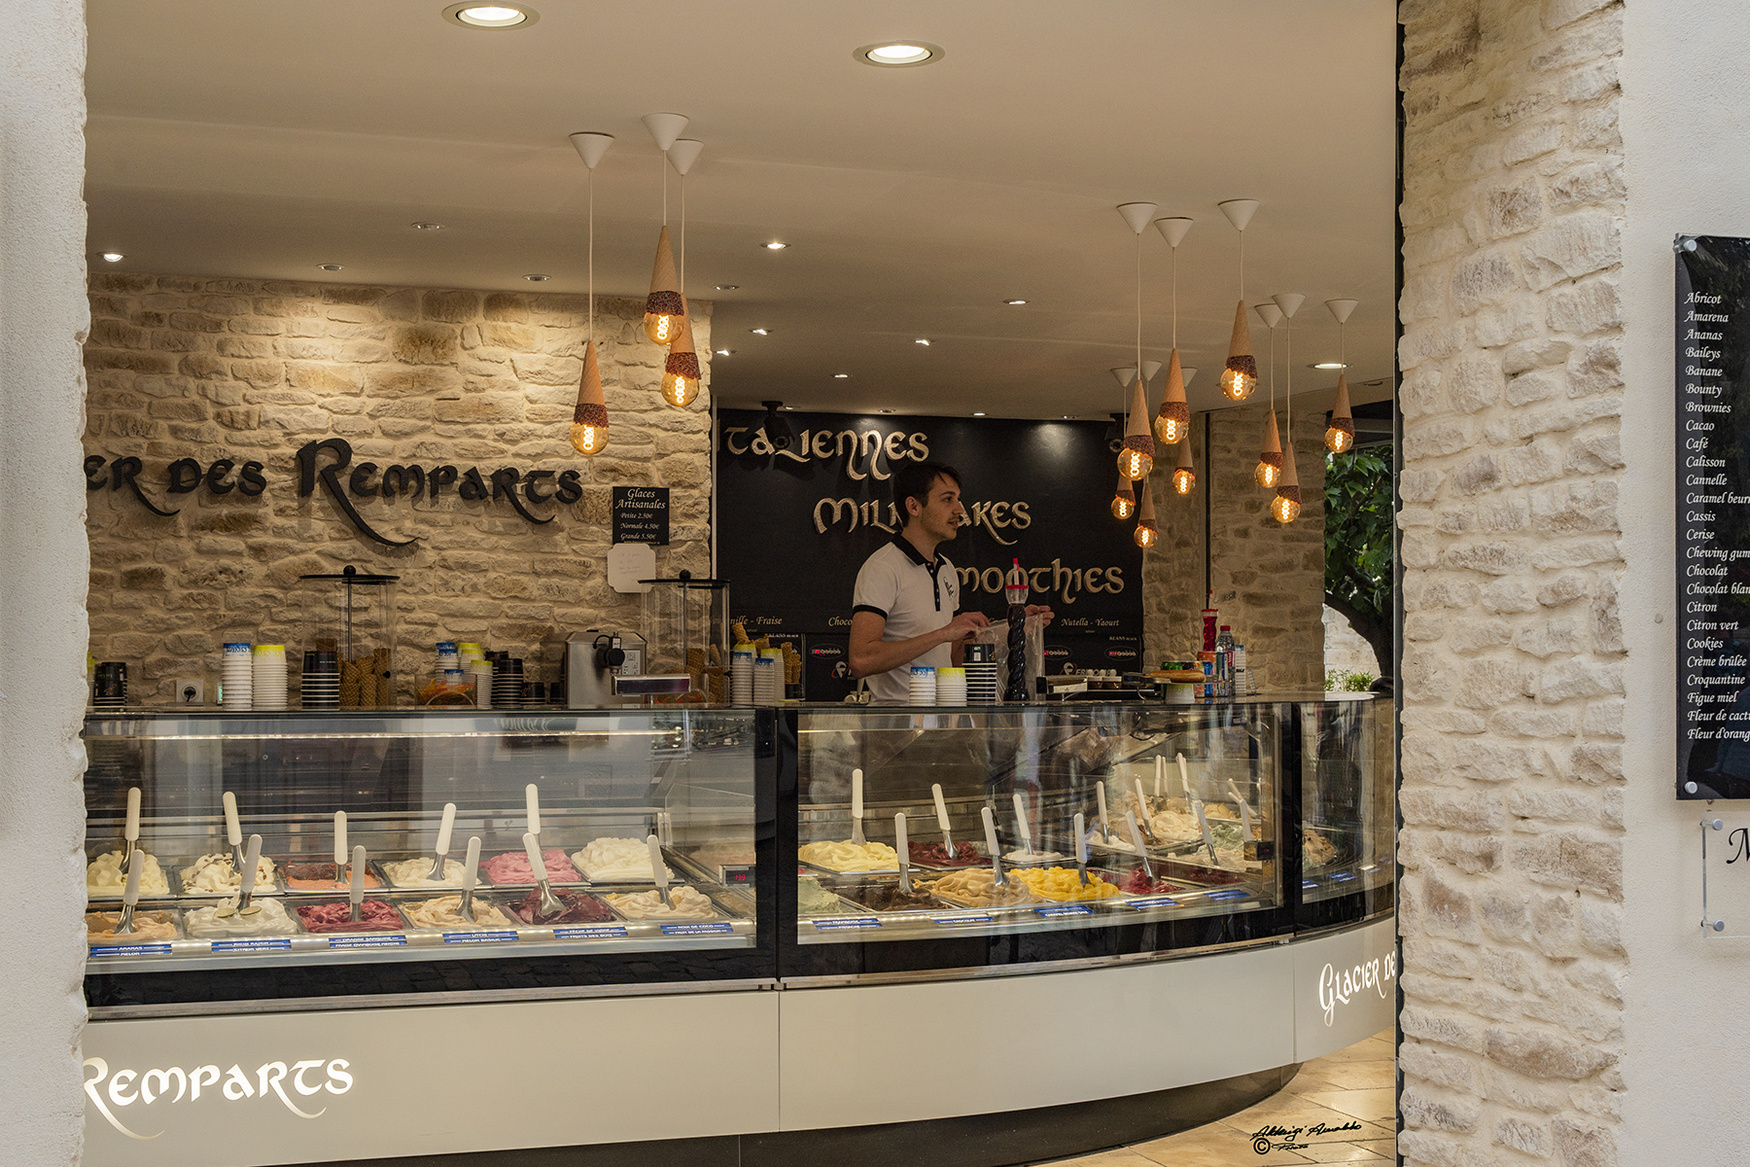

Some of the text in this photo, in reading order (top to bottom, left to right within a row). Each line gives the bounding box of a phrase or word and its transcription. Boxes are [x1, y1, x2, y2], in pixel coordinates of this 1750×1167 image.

[1683, 291, 1722, 305] Abricot
[1683, 310, 1729, 323] Amarena
[1683, 328, 1723, 341] Ananas
[1684, 346, 1722, 362] Baileys
[1684, 364, 1723, 377] Banane
[1684, 383, 1723, 399] Bounty
[1684, 401, 1732, 413] Brownies
[1685, 419, 1715, 432] Cacao
[1685, 437, 1709, 451] Café
[1685, 455, 1726, 468] Calisson
[1685, 474, 1728, 487] Cannelle
[627, 487, 656, 500] Glaces
[1686, 491, 1728, 504] Caramel
[615, 498, 666, 509] Artisanales
[1686, 510, 1717, 523] Cassis
[1686, 528, 1715, 541] Cerise
[1686, 546, 1750, 562] Chewing gum
[1686, 563, 1729, 577] Chocolat
[1686, 582, 1750, 596] Chocolat blan
[1686, 600, 1718, 614] Citron
[756, 615, 783, 626] Fraise
[1060, 617, 1089, 627] Nutella
[1095, 618, 1120, 627] Yaourt
[1686, 619, 1740, 632] Citron vert
[1686, 636, 1724, 651] Cookies
[1686, 654, 1747, 668] Crème brûlée
[1686, 673, 1746, 688] Croquantine
[1687, 690, 1739, 707] Figue miel
[1687, 709, 1715, 721] Fleur
[1715, 708, 1727, 721] de
[1687, 726, 1750, 743] Fleur d'orang
